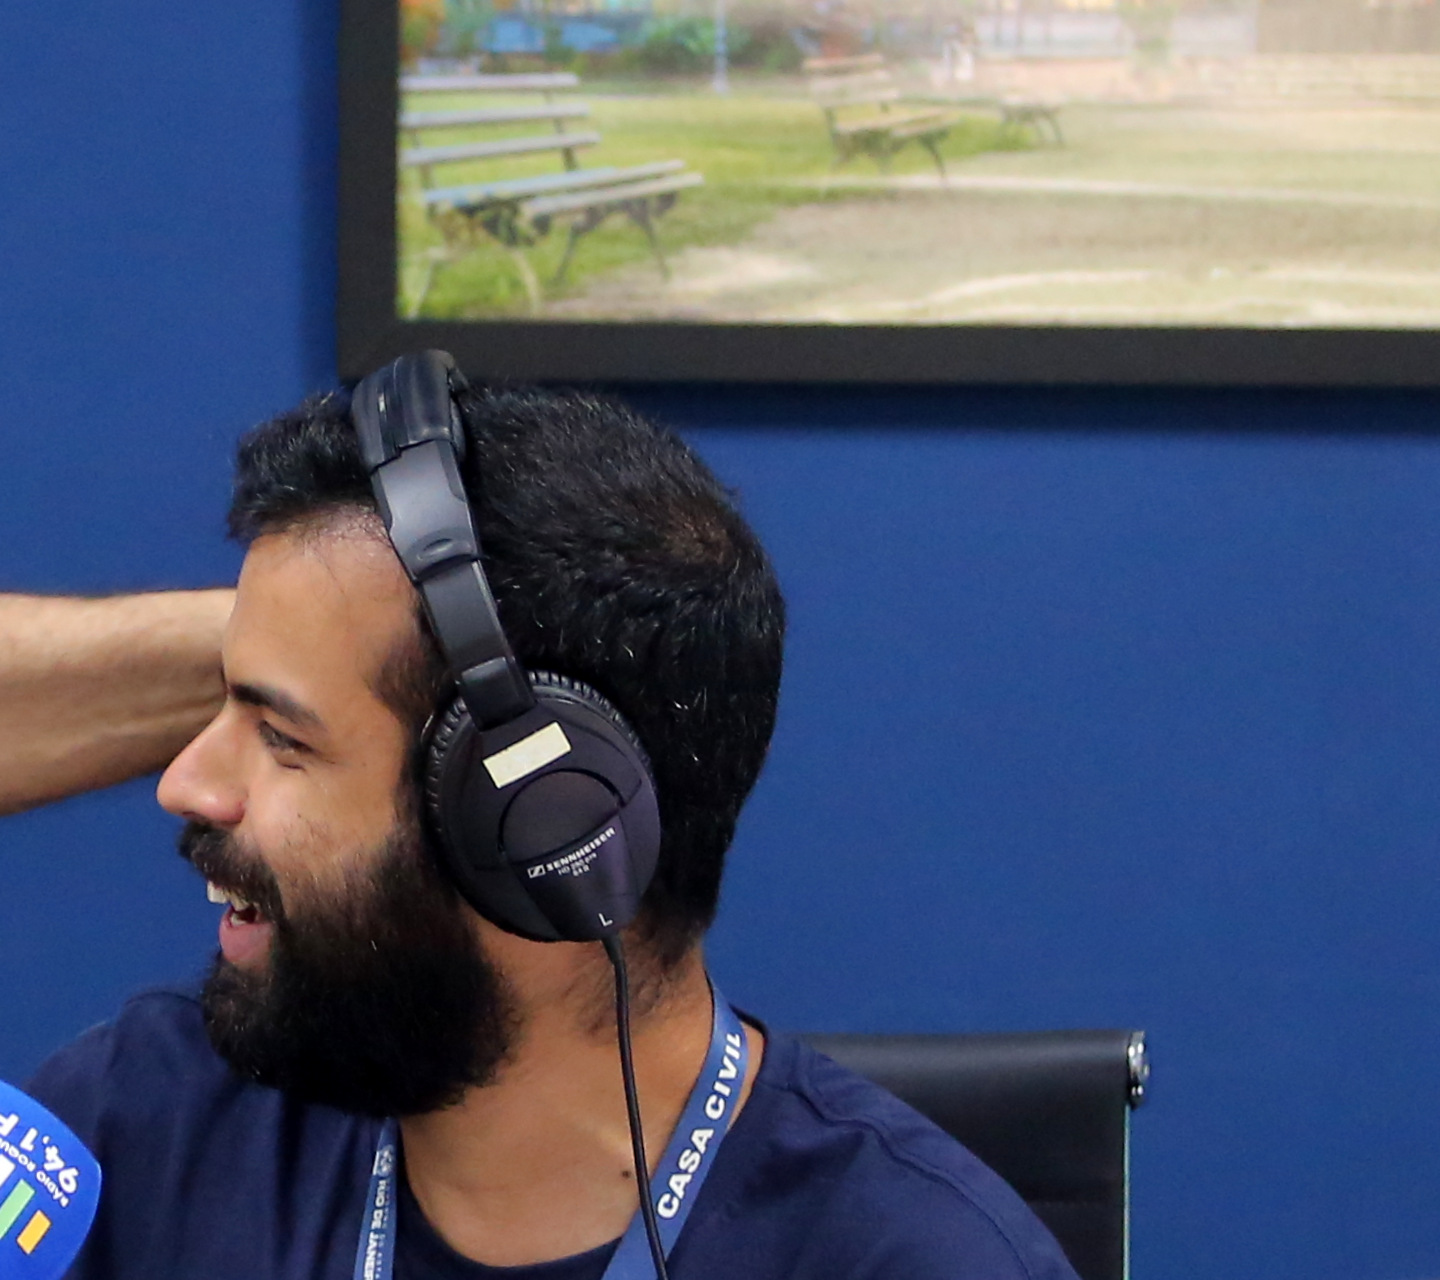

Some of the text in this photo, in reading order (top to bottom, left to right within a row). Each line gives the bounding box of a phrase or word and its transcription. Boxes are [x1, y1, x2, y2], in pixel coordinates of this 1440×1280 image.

[545, 826, 616, 873] SENNHEISER
[598, 912, 613, 927] L
[656, 1030, 742, 1220] CASA CIVIL
[20, 1126, 80, 1194] 94,1
[371, 1209, 384, 1230] DE
